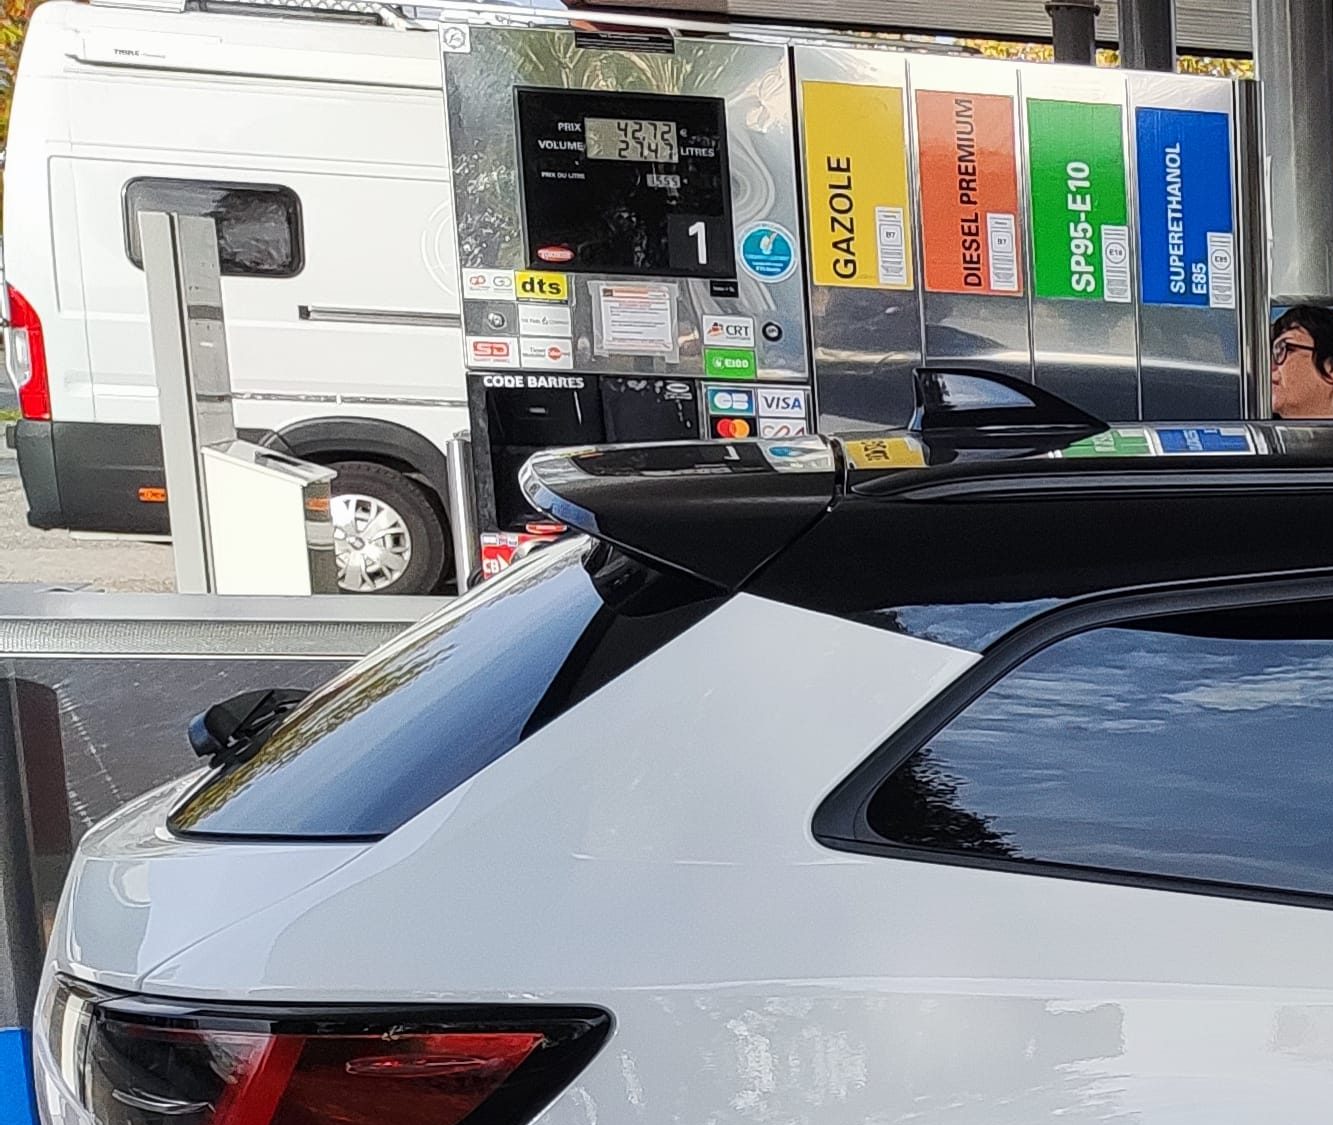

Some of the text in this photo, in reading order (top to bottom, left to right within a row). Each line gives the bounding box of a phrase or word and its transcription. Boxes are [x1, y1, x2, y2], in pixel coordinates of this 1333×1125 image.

[557, 121, 582, 132] PRIX
[537, 139, 585, 151] VOLUME
[680, 146, 715, 157] LITRES
[954, 98, 983, 287] DIESEL PREMIUM
[826, 155, 857, 279] GAZOLE
[1066, 160, 1096, 293] SP95-E10
[1164, 142, 1186, 294] SUPERETHANOL
[688, 221, 708, 265] 1
[521, 276, 562, 295] dts
[1191, 262, 1207, 294] E85
[725, 324, 750, 337] CRT
[483, 375, 585, 389] CODE BARRES
[762, 395, 803, 410] VISA
